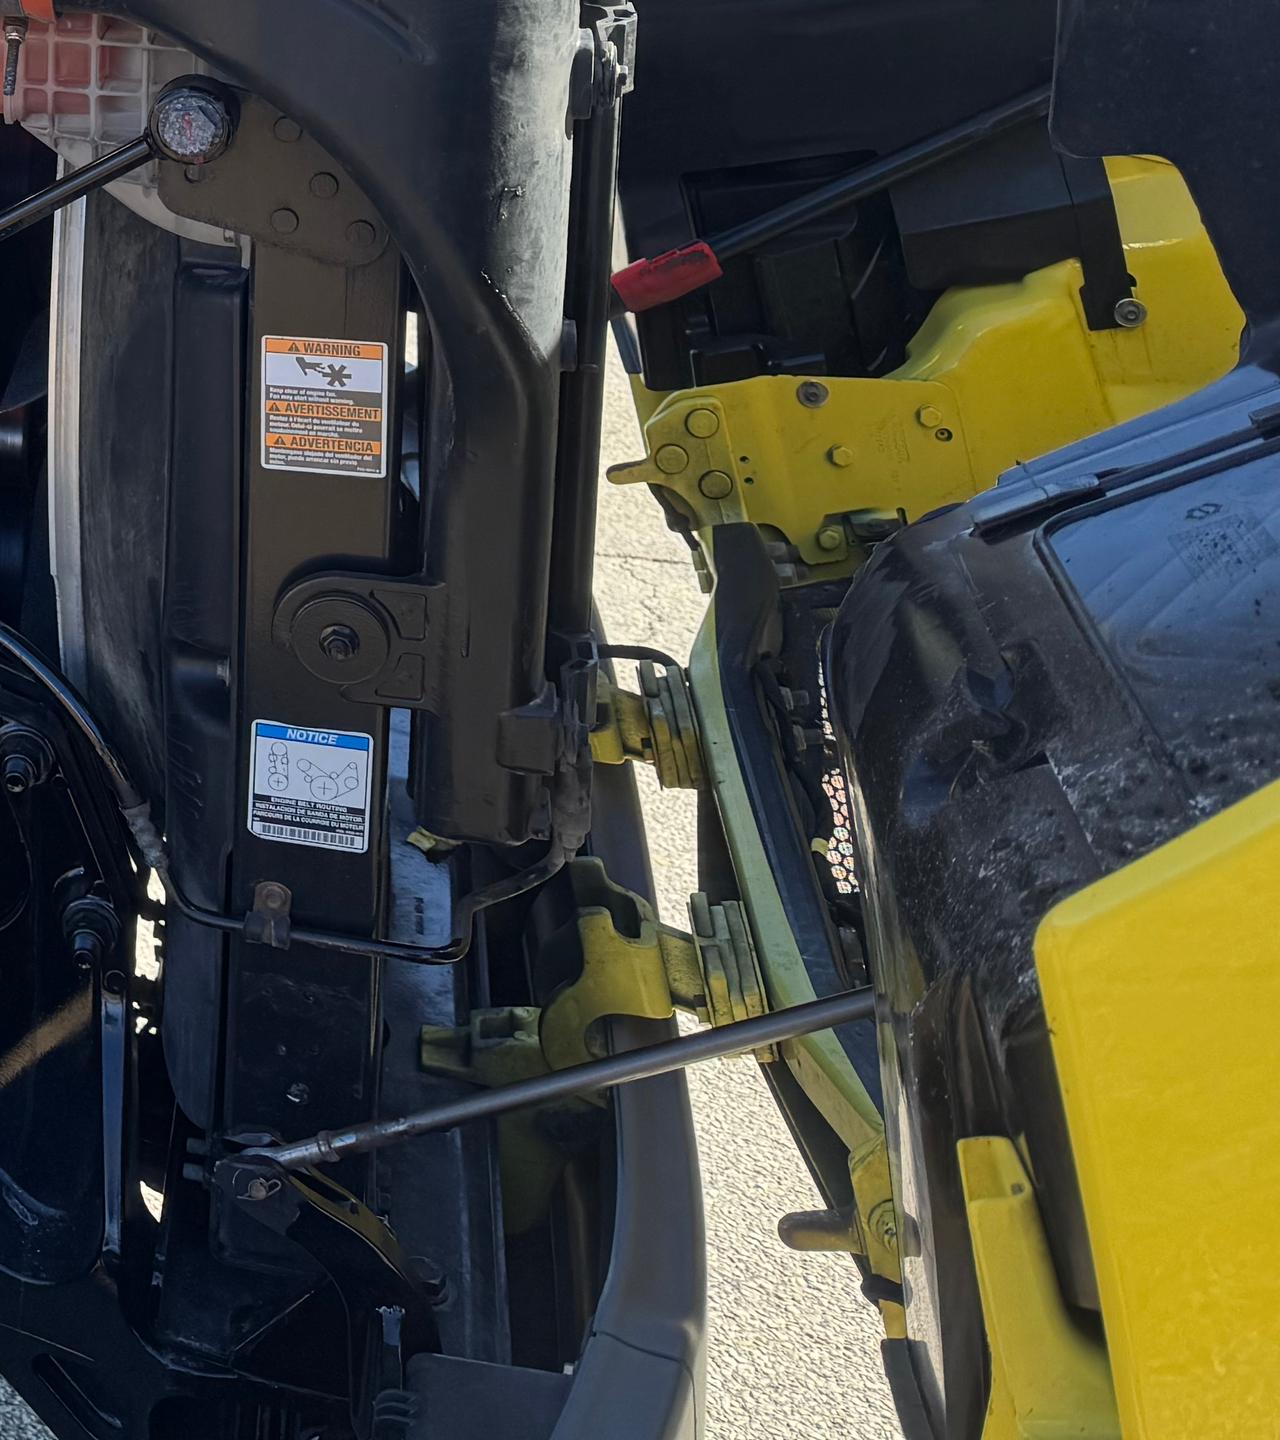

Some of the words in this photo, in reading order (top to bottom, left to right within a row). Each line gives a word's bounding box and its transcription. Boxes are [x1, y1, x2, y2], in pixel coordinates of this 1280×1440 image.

[303, 342, 361, 357] WARNING
[285, 402, 379, 420] AVERTISSEMENT
[290, 436, 373, 453] ADVERTENCIA
[286, 728, 339, 745] NOTICE
[271, 797, 296, 806] ENGINE
[298, 800, 315, 808] BELT
